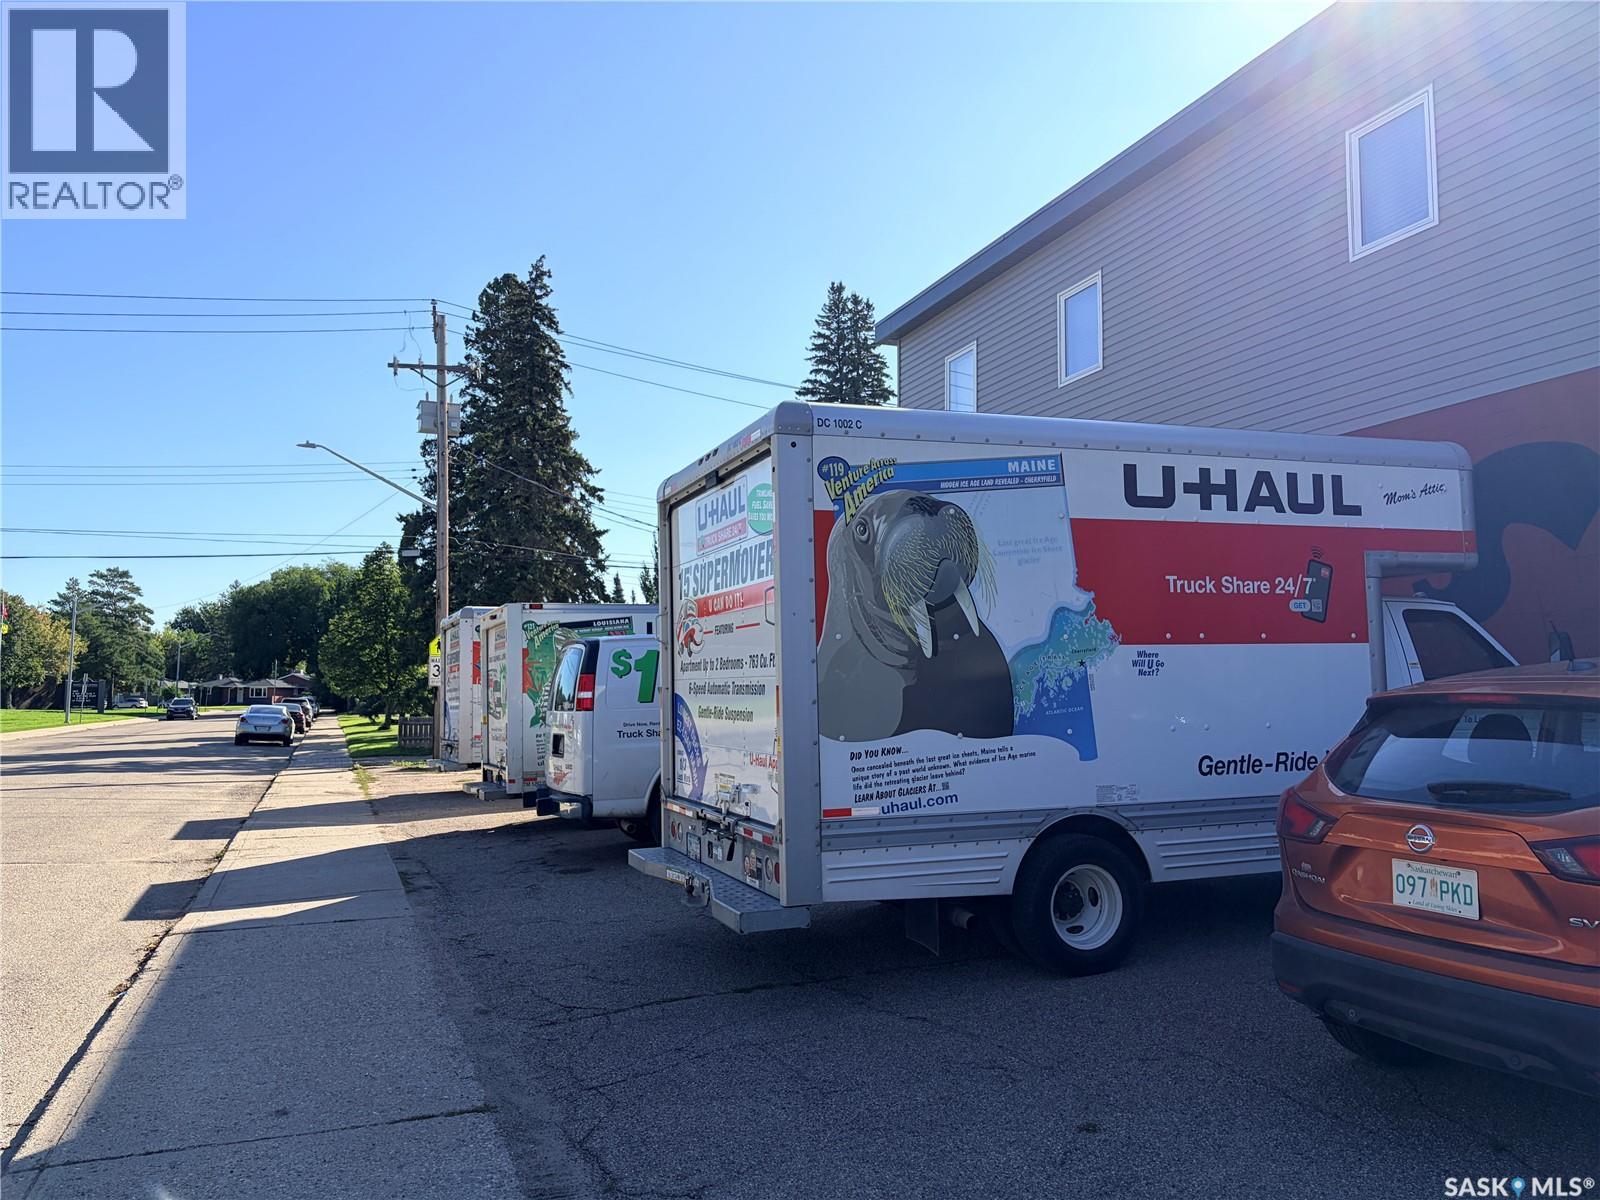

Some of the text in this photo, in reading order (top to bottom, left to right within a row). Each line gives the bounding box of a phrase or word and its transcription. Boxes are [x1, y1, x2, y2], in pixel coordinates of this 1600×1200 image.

[817, 418, 862, 429] DC 1002 C
[822, 462, 844, 477] #119
[1007, 459, 1056, 473] MAINE
[824, 457, 897, 501] Venture Across
[940, 480, 959, 488] HIDDEN
[960, 479, 969, 487] ICE
[970, 479, 980, 487] AGE
[981, 478, 994, 486] LAND
[995, 477, 1019, 485] REVEALED
[1024, 475, 1056, 483] CHERRYFIELD
[843, 467, 895, 526] America
[1123, 463, 1362, 516] U-HAUL
[1383, 489, 1416, 505] Mom's
[698, 486, 745, 531] U-HAUL
[693, 539, 774, 597] SUPERMOVER
[1165, 574, 1313, 598] Truck Share 24/7
[713, 596, 725, 611] CAN
[725, 594, 733, 609] DO
[593, 618, 630, 627] LOUISIANA
[715, 623, 734, 635] FEATURING
[1137, 650, 1159, 658] Where
[680, 660, 702, 674] Apartment
[703, 658, 709, 673] Up
[720, 657, 744, 670] Bedrooms
[748, 654, 759, 669] 763
[760, 653, 769, 668] Cu.
[1147, 660, 1153, 669] U
[689, 681, 765, 696] 6-Speed Automatic Transmission
[698, 705, 753, 724] Gentle-Ride Suspension
[617, 729, 644, 738] Truck
[750, 752, 767, 768] U-Haul
[850, 751, 862, 760] DID
[864, 749, 879, 759] YOU
[867, 761, 892, 771] concealed
[894, 758, 914, 767] beneath
[926, 755, 936, 763] last
[938, 754, 950, 762] great
[899, 768, 910, 776] past
[953, 760, 967, 768] What
[969, 757, 990, 766] evidence
[1008, 753, 1018, 761] Age
[1198, 751, 1318, 776] Gentle-Ride
[853, 783, 862, 791] life
[874, 780, 883, 788] the
[884, 777, 910, 786] retreating
[911, 775, 928, 783] glacier
[945, 767, 966, 778] behind?
[854, 793, 874, 803] LEARN
[875, 790, 896, 800] ABOUT
[898, 785, 926, 797] GLACIERS
[881, 794, 958, 815] uhaul.com
[1410, 864, 1457, 879] Saskatchewan
[1396, 874, 1473, 906] 097 PKD
[1569, 917, 1600, 928] SV
